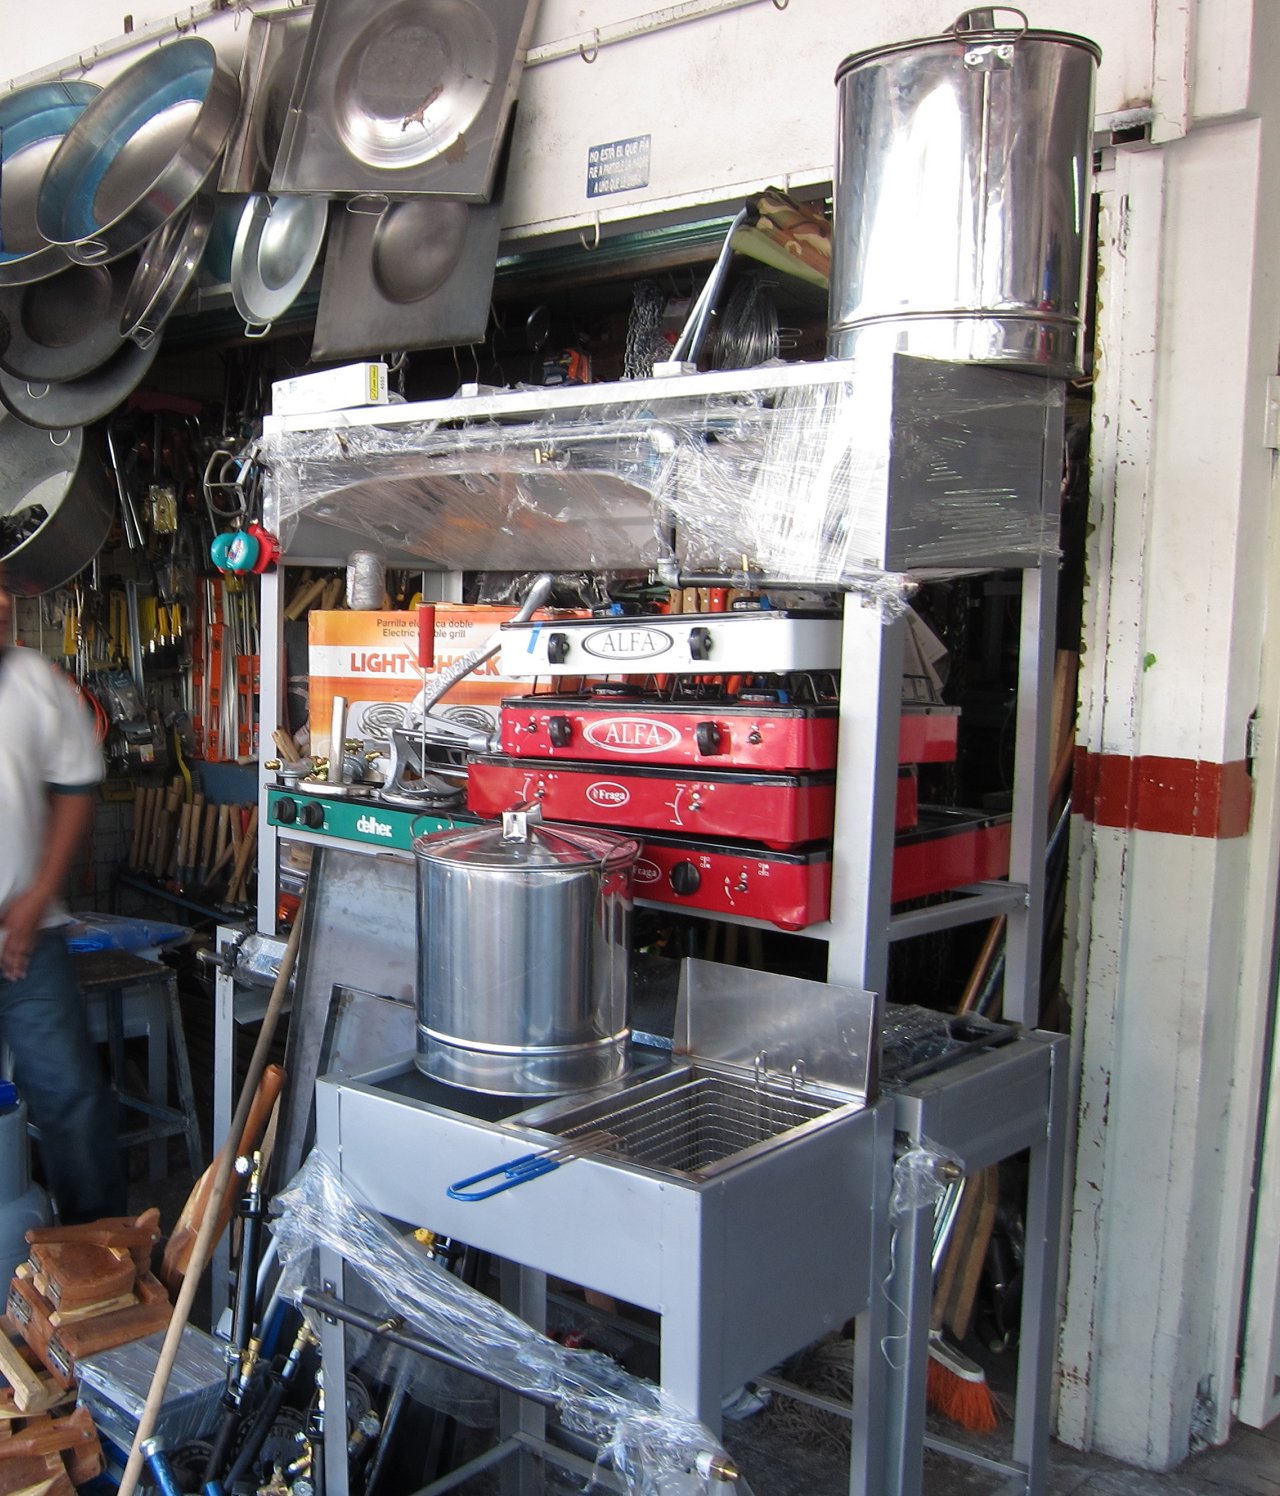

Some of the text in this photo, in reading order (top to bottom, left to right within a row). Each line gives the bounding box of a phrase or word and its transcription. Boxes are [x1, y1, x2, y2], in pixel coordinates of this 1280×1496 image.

[376, 618, 407, 628] Parrilla
[448, 617, 473, 629] doble
[382, 628, 415, 638] Electric
[449, 628, 466, 640] grill
[602, 631, 656, 652] ALFA
[350, 652, 409, 674] LIGHT
[604, 723, 662, 746] ALFA
[598, 789, 625, 802] Fraga
[632, 865, 657, 878] Fraga
